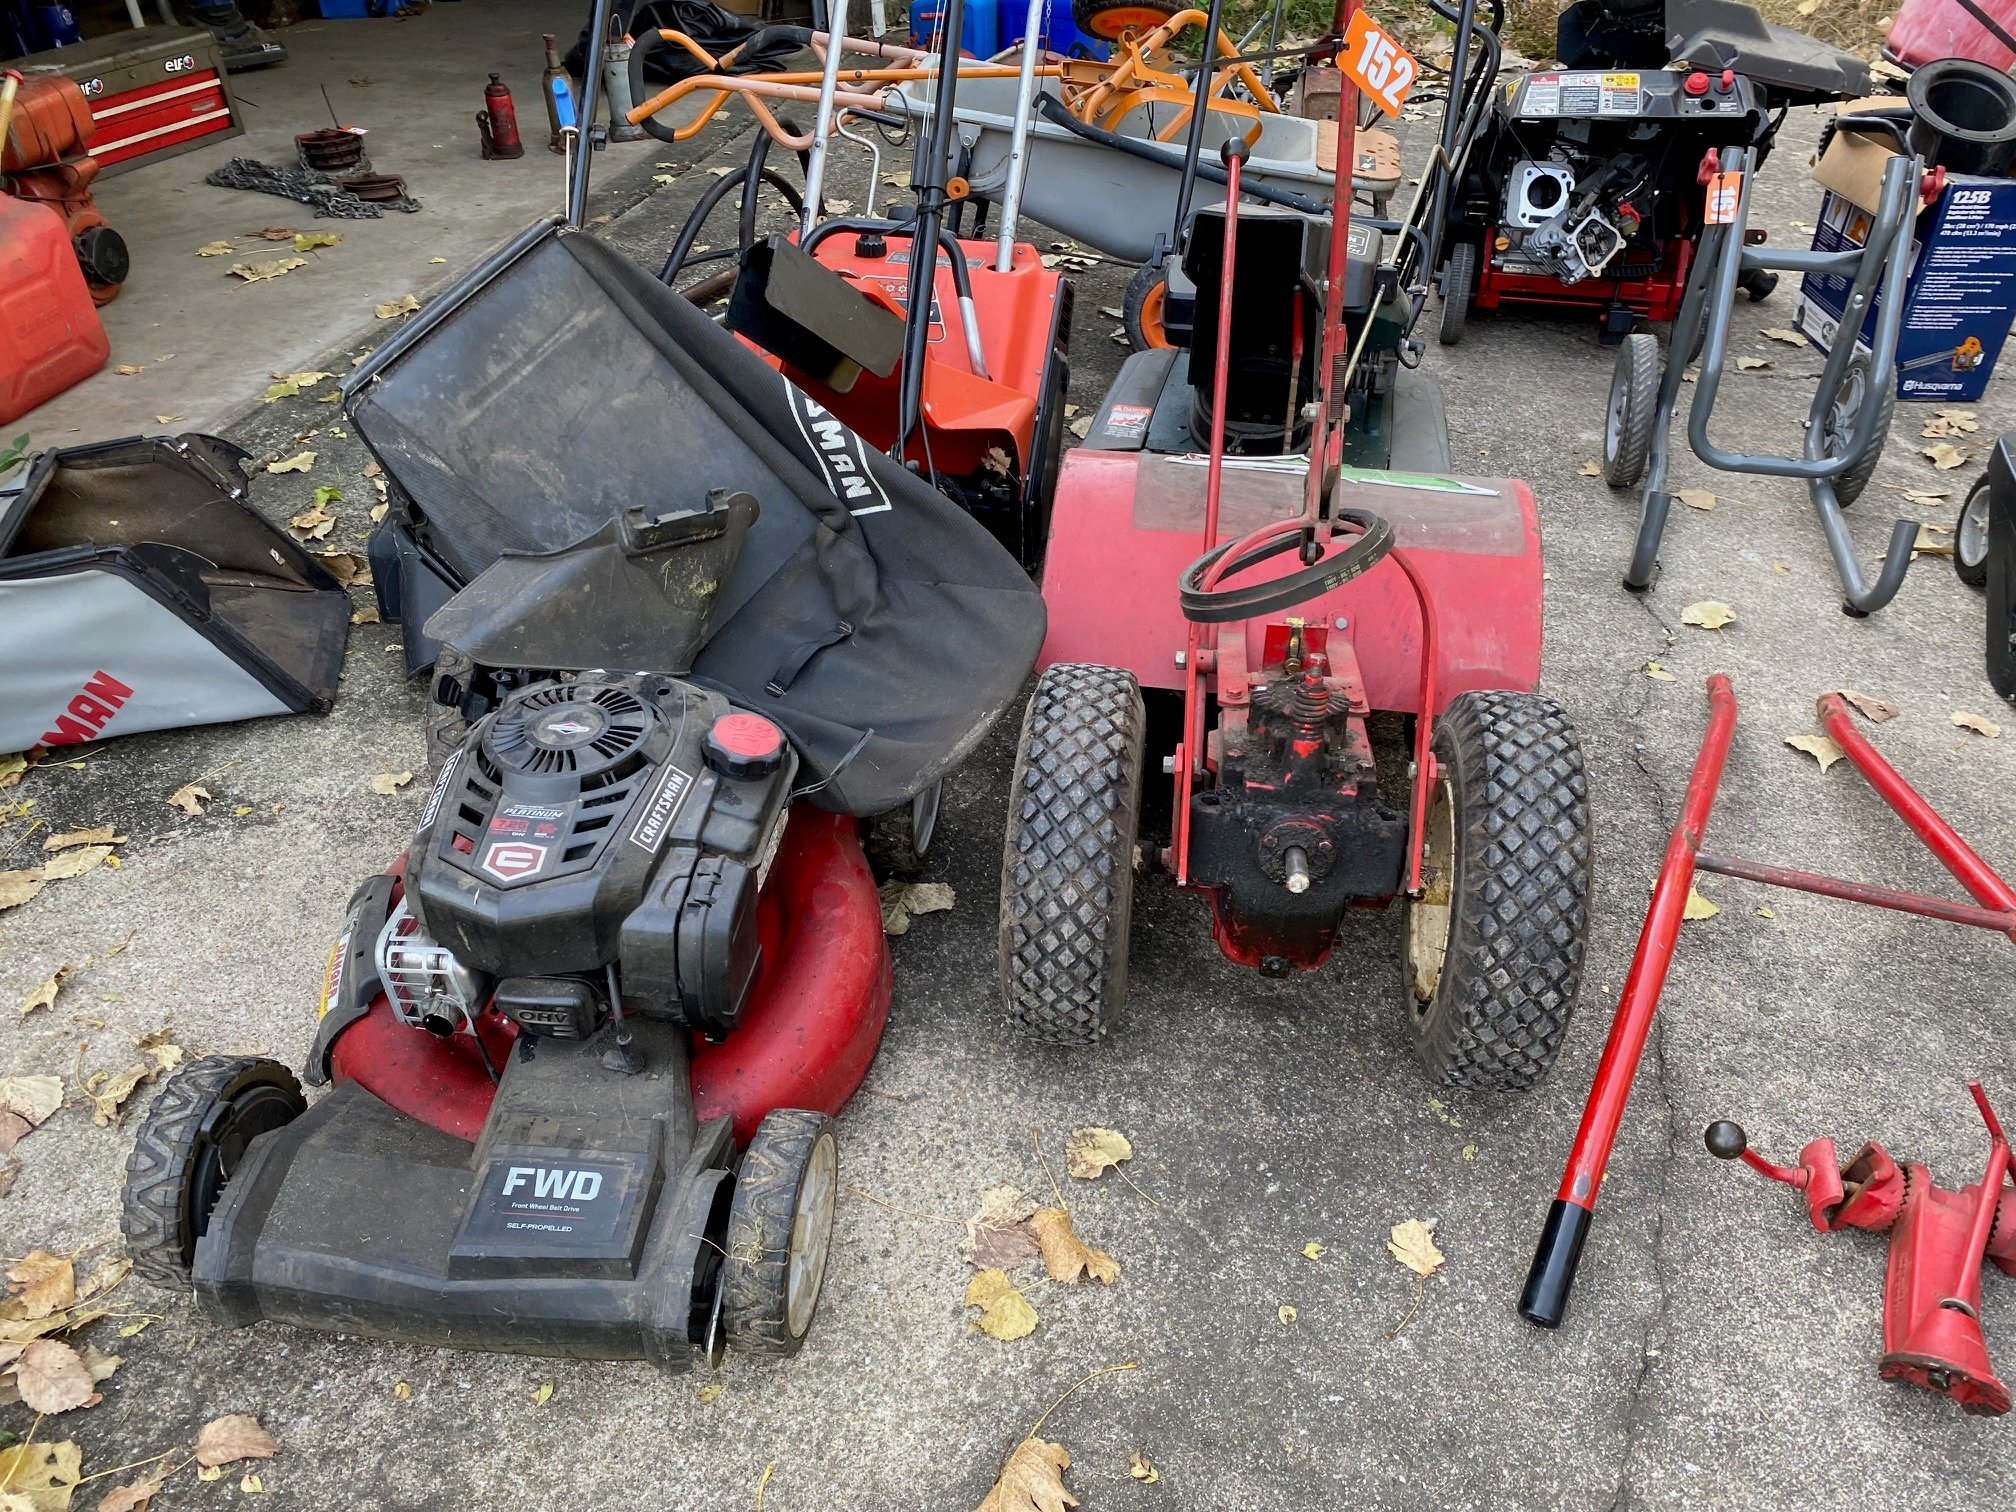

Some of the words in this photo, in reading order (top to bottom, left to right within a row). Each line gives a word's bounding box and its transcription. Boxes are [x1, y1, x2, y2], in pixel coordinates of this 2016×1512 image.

[1356, 31, 1413, 108] 152
[80, 82, 91, 95] lf
[1710, 186, 1736, 222] 167
[1952, 190, 1992, 204] 125B
[1914, 382, 1963, 391] Husqvarna
[1123, 406, 1150, 415] DANGER
[31, 669, 134, 750] MAN
[422, 757, 456, 826] CRAFTSMAN
[503, 808, 564, 818] PLATINUM
[640, 773, 685, 844] CRAFTSMAN
[328, 943, 347, 999] DANGER
[519, 1010, 568, 1024] OHV
[502, 1167, 603, 1201] FWD
[511, 1202, 528, 1210] Front
[529, 1203, 548, 1211] Wheel
[506, 1222, 573, 1232] SELF-PROPELLED
